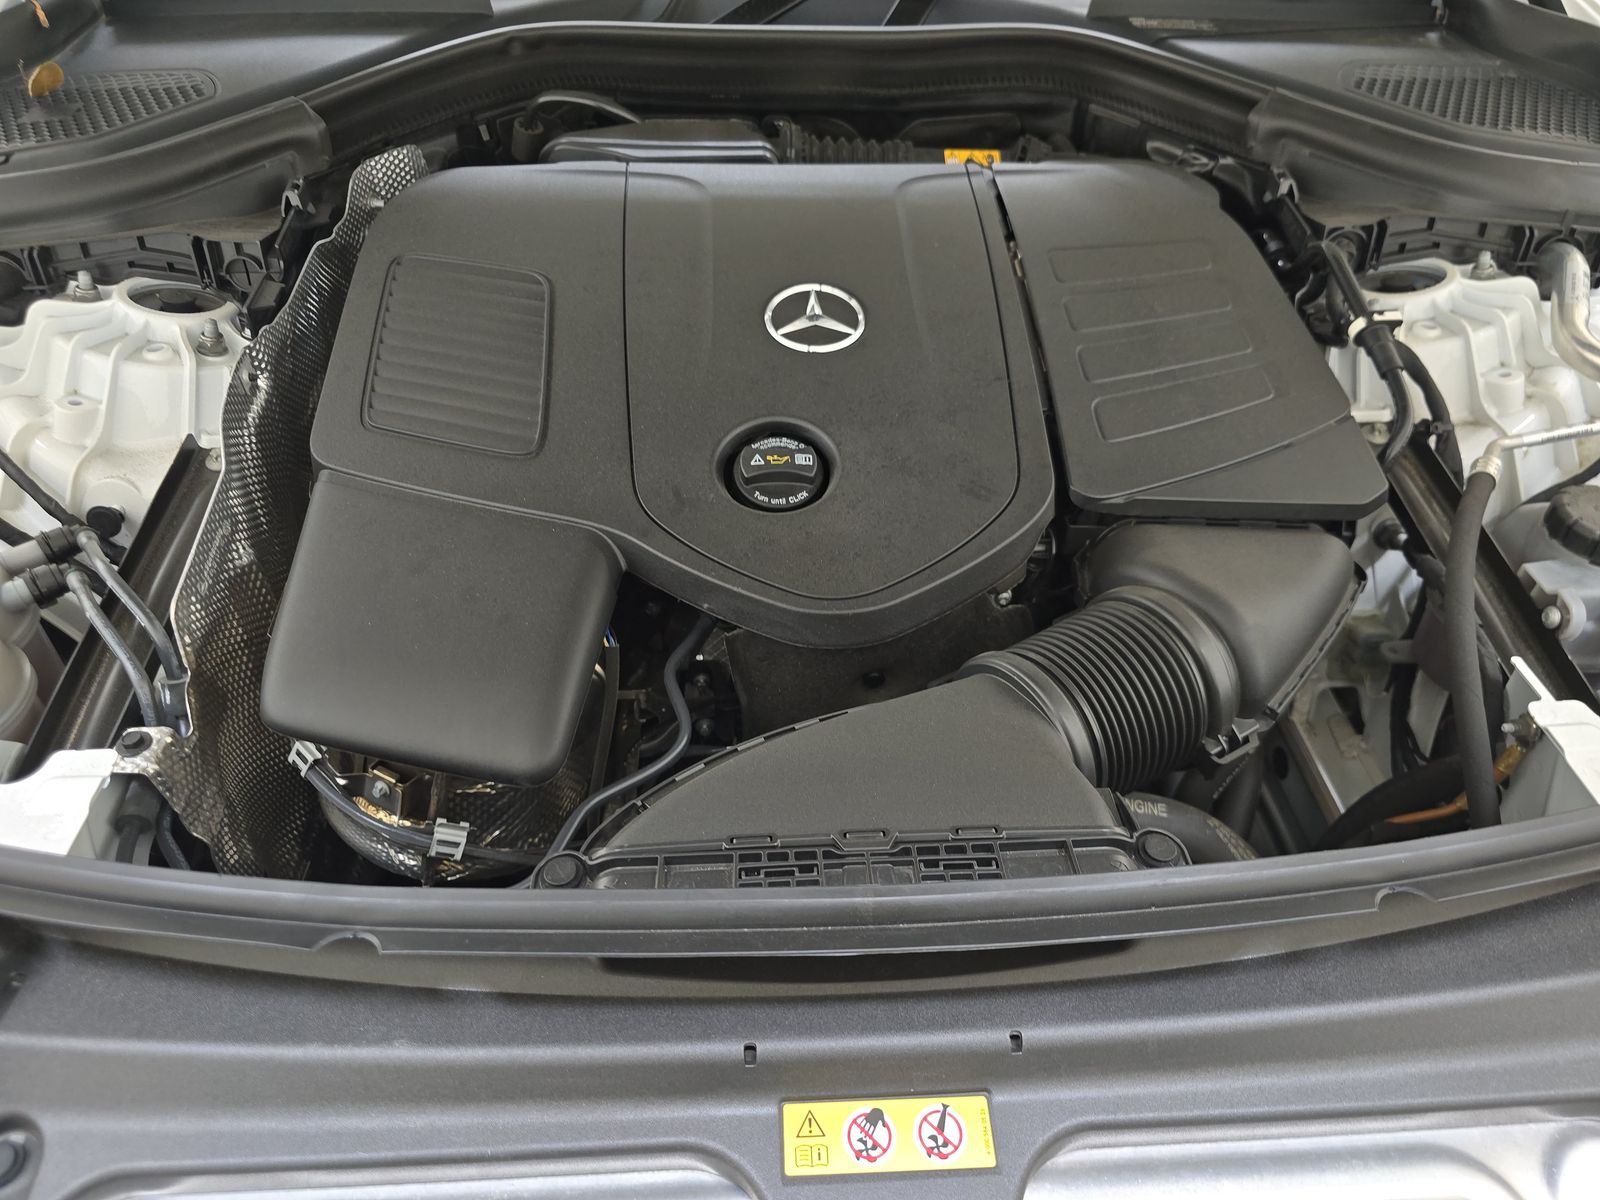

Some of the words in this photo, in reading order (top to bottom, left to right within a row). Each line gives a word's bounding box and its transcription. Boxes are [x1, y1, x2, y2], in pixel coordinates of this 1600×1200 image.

[754, 490, 769, 503] Turn
[770, 497, 786, 505] until
[789, 490, 809, 504] CLICK
[1125, 798, 1168, 817] NGINE
